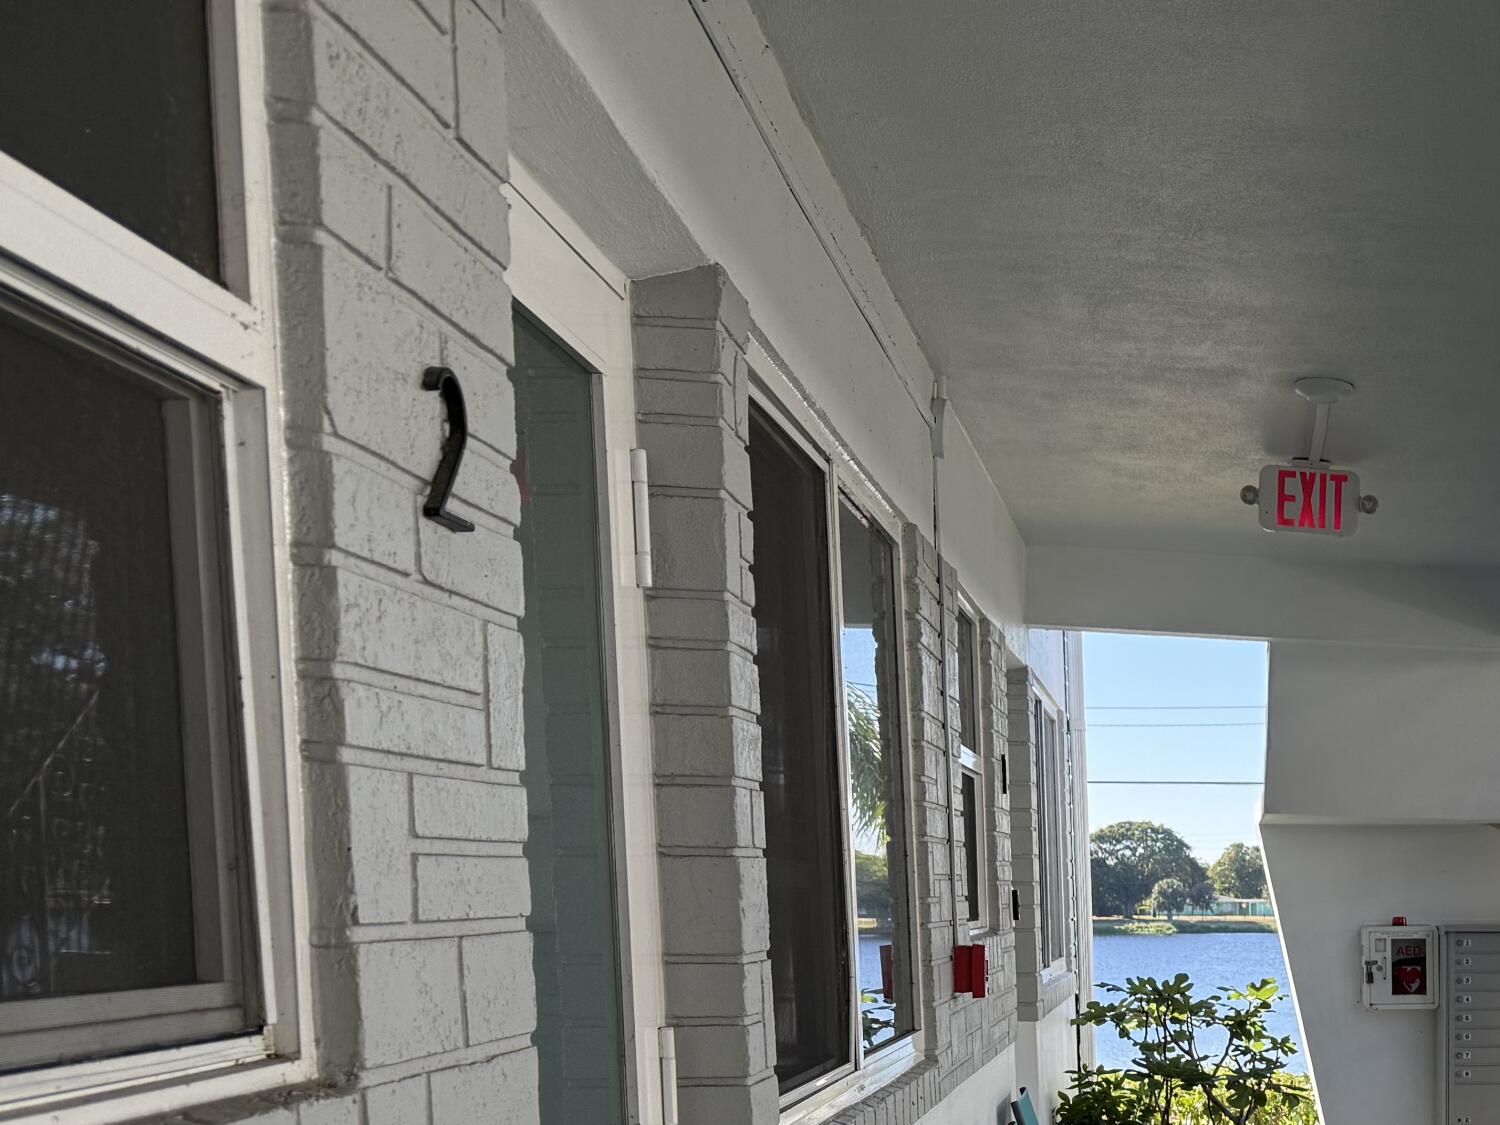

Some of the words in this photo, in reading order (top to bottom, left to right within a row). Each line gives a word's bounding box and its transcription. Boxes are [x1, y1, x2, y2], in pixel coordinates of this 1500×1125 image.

[420, 365, 476, 534] 2
[1276, 469, 1349, 532] EXIT
[1396, 945, 1422, 957] AED
